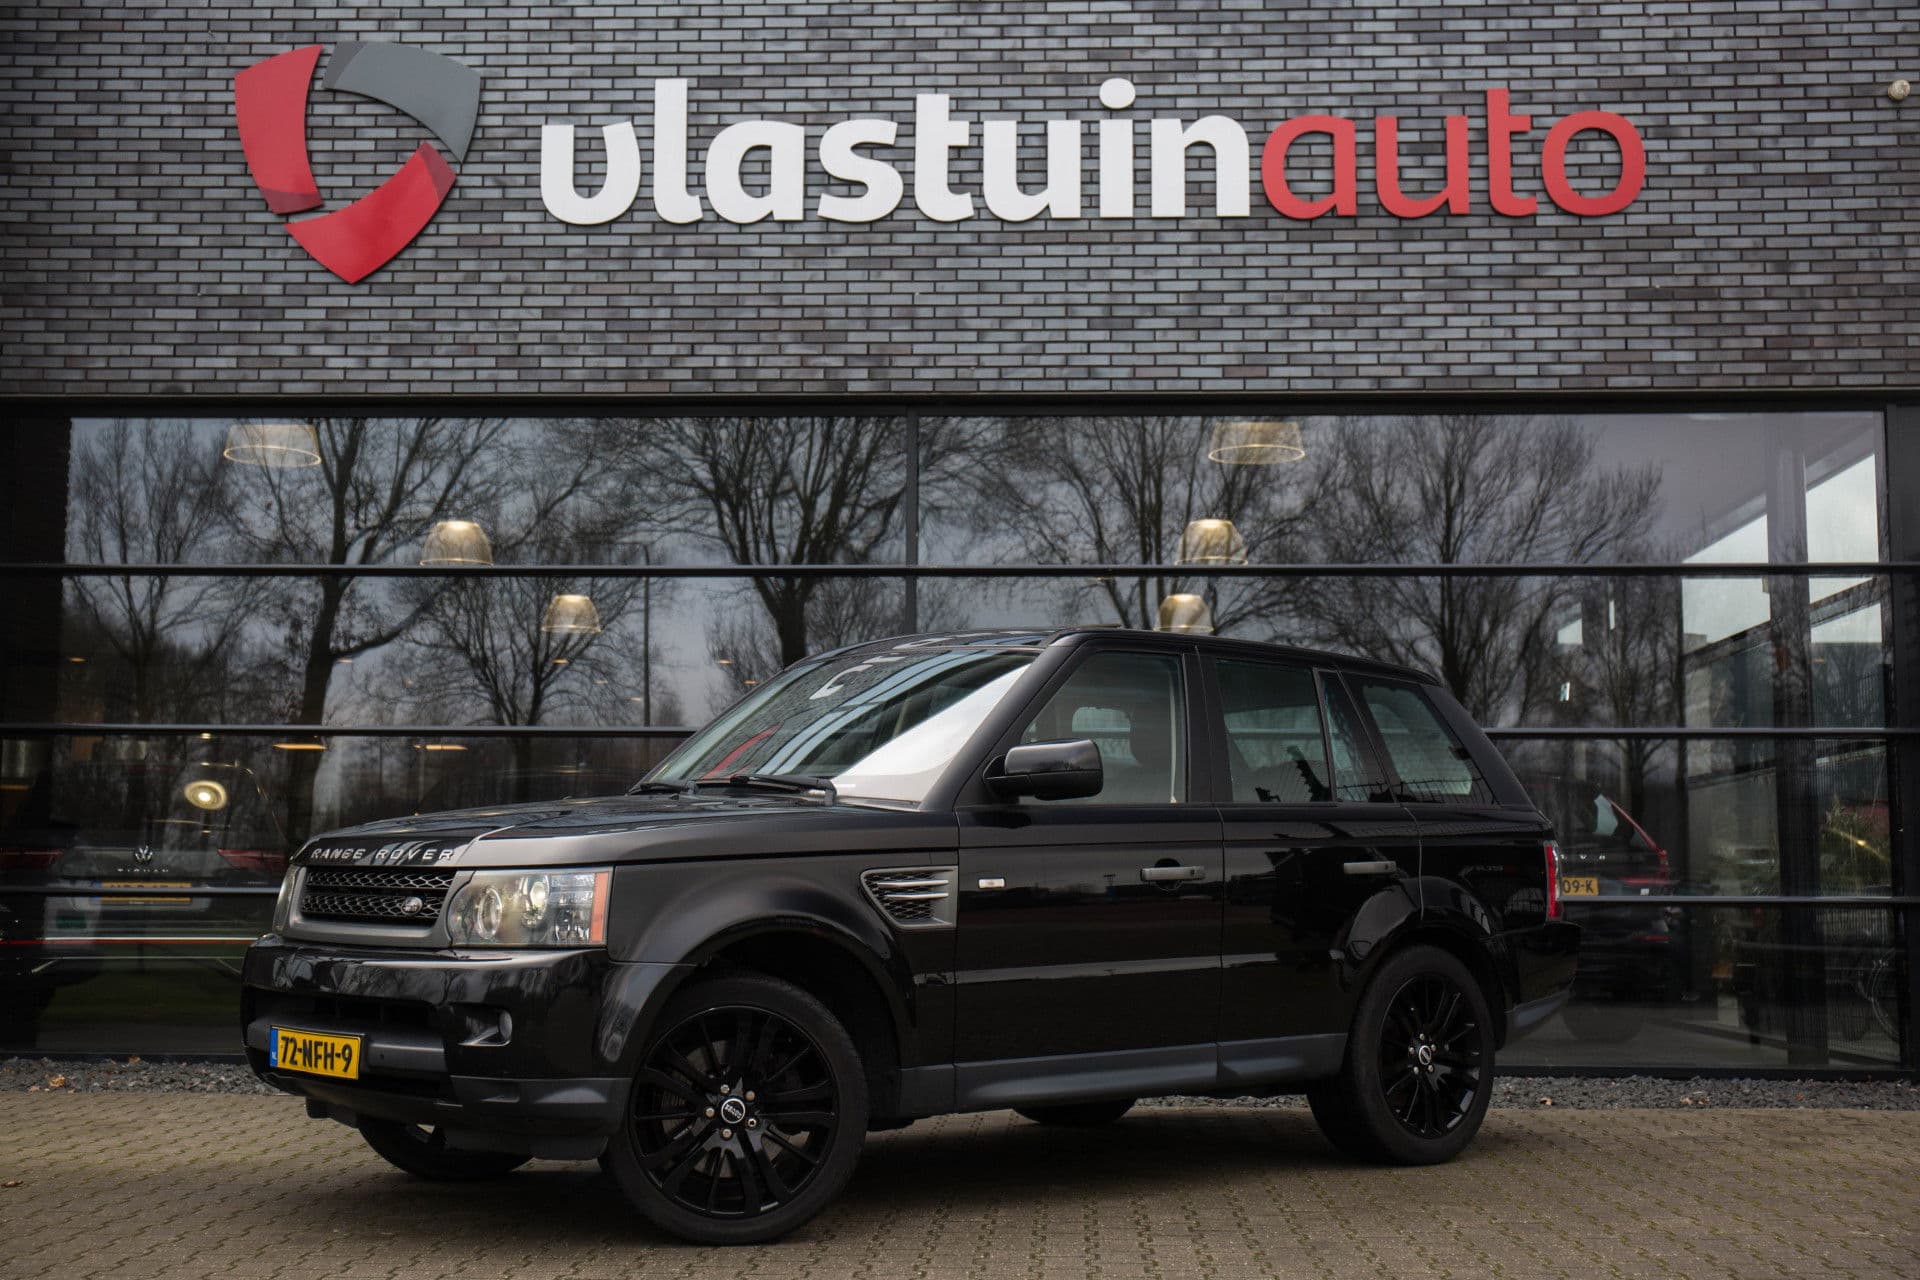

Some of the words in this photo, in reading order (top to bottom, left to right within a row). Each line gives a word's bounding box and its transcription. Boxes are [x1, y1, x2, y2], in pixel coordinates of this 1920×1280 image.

[311, 848, 366, 860] RANGE
[375, 848, 455, 861] ROVER
[280, 1035, 353, 1073] 72-NFH-9
